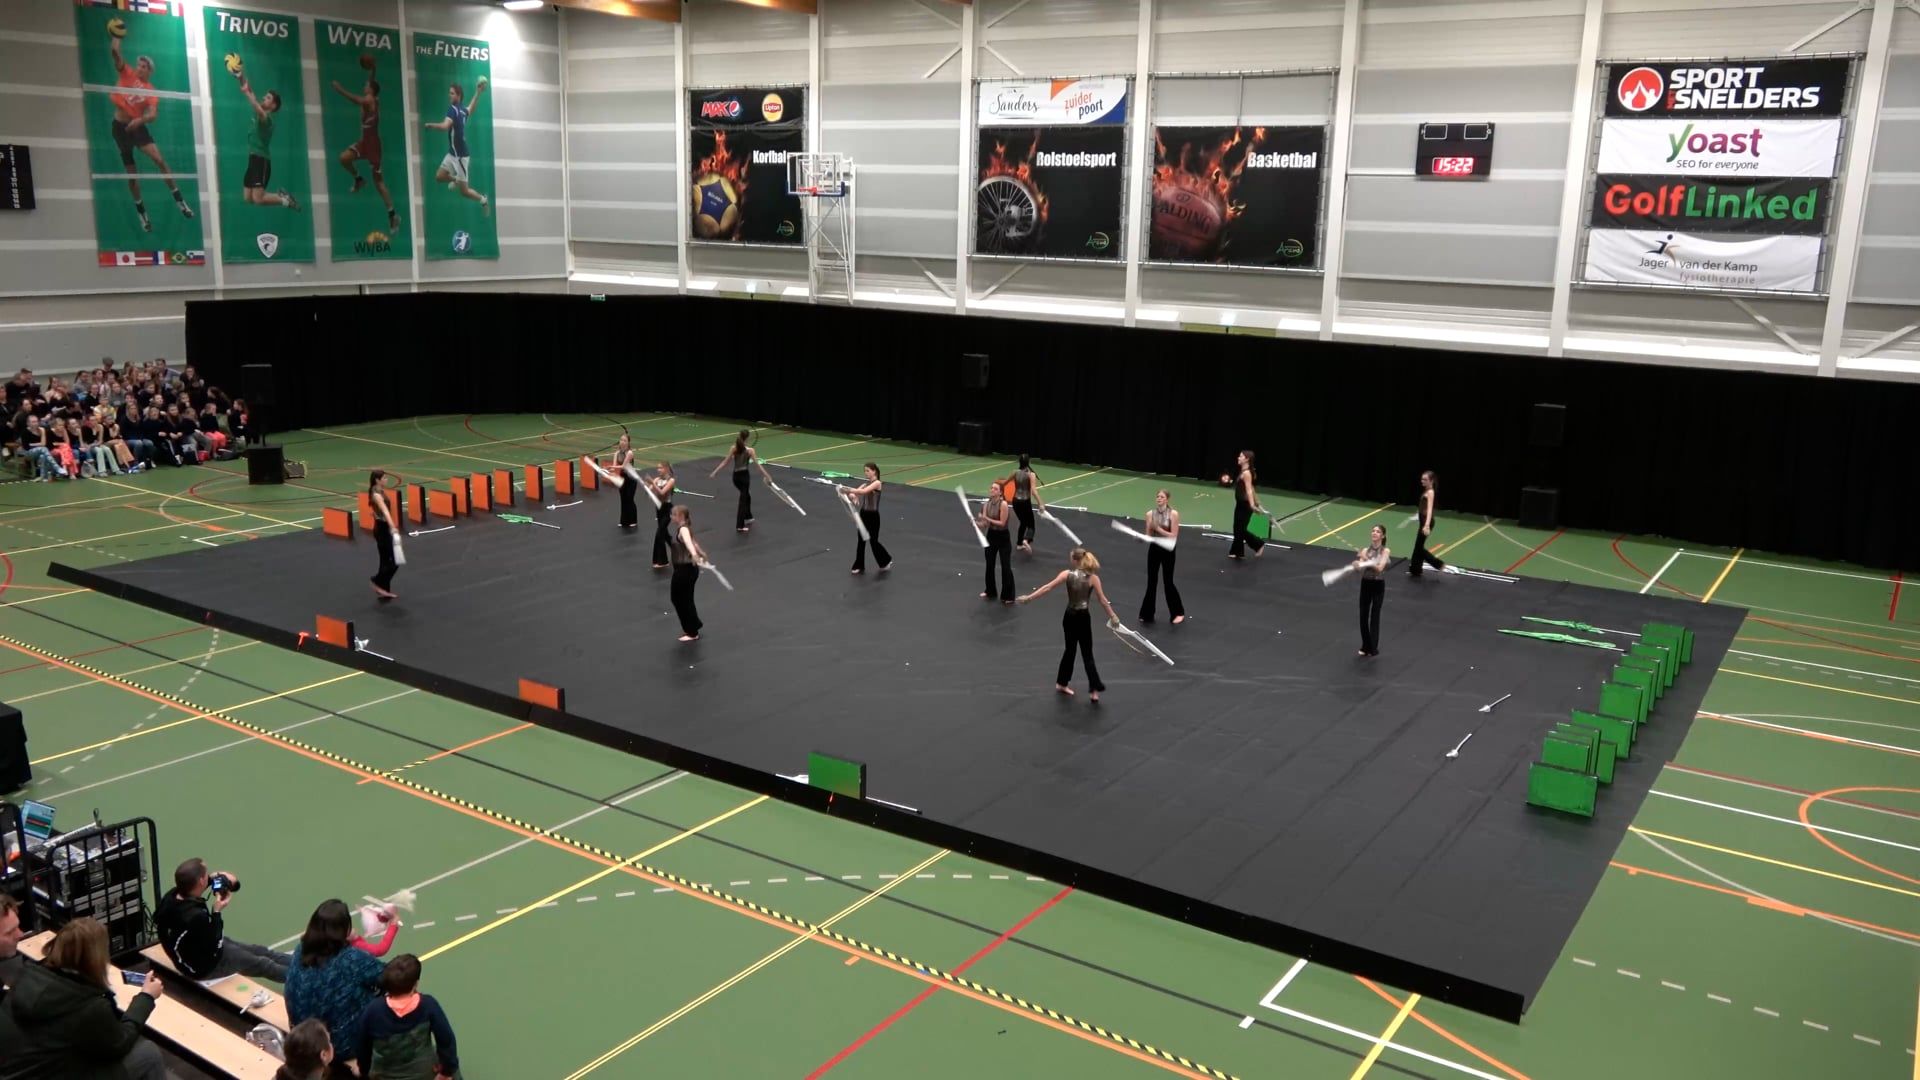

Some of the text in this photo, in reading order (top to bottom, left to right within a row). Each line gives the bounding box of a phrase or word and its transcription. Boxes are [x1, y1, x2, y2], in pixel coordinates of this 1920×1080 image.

[216, 11, 289, 38] TRIVOS
[327, 24, 392, 50] WYBA
[415, 40, 489, 61] THE FLYERS
[1670, 67, 1764, 89] SPORT
[989, 93, 1040, 115] Sanders
[1064, 91, 1092, 110] zuider
[1674, 87, 1820, 110] SNELDERS
[701, 101, 731, 118] MAX
[1079, 99, 1103, 120] poort
[753, 150, 786, 164] Korfbal
[1036, 151, 1117, 168] Rolstoelsport
[1247, 151, 1317, 168] Basketbal
[1438, 158, 1473, 172] 15:22
[1676, 160, 1759, 170] SEO for everyone
[1604, 184, 1818, 220] GolfLinked
[1639, 257, 1758, 273] Jager van der Kamp
[1680, 273, 1756, 285] fysiotherapie
